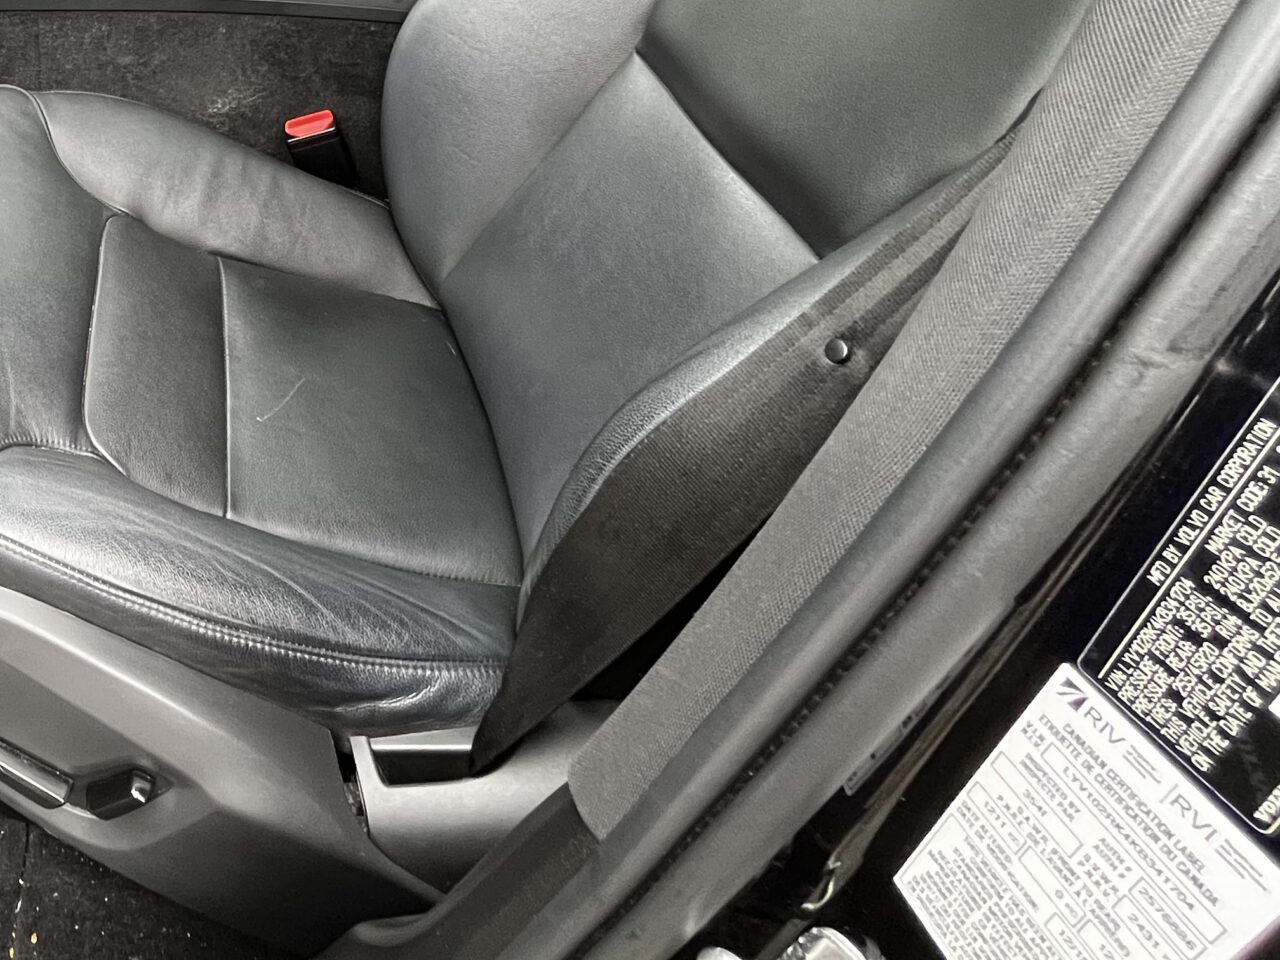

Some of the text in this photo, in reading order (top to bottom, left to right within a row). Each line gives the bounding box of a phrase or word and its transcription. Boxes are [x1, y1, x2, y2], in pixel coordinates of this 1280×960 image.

[1161, 544, 1182, 564] BY
[1173, 509, 1209, 546] VOLVO
[1199, 485, 1227, 512] CAR
[1216, 417, 1277, 488] CORPORATION
[1204, 508, 1245, 556] MARKET
[1117, 655, 1160, 706] PRESSURE
[1150, 624, 1184, 660] FRONT:
[1235, 509, 1268, 546] COLD
[1131, 667, 1175, 719] PRESSURE
[1252, 525, 1280, 558] COLD
[1084, 706, 1126, 744] RIV
[1159, 715, 1188, 744] THIS
[1177, 673, 1221, 719] VEHICLE
[1211, 624, 1261, 679] CONFORMS
[1249, 608, 1274, 628] TO
[1171, 641, 1220, 698] 255/45R20
[1175, 710, 1218, 757] VEHICLE
[1207, 672, 1248, 717] SAFETY
[1238, 650, 1267, 679] AND
[1190, 749, 1214, 772] ON
[1202, 729, 1230, 756] THE
[1218, 701, 1253, 737] DATE
[1242, 685, 1264, 708] OF
[1063, 723, 1108, 770] CANADIAN
[1106, 768, 1175, 841] CERTIFICATION
[1173, 839, 1205, 874] LABEL
[1081, 759, 1095, 774] DE
[1094, 773, 1161, 844] CERTIFICATION
[1159, 843, 1178, 862] DU
[1176, 861, 1218, 907] CANADA
[1170, 794, 1217, 842] RVI
